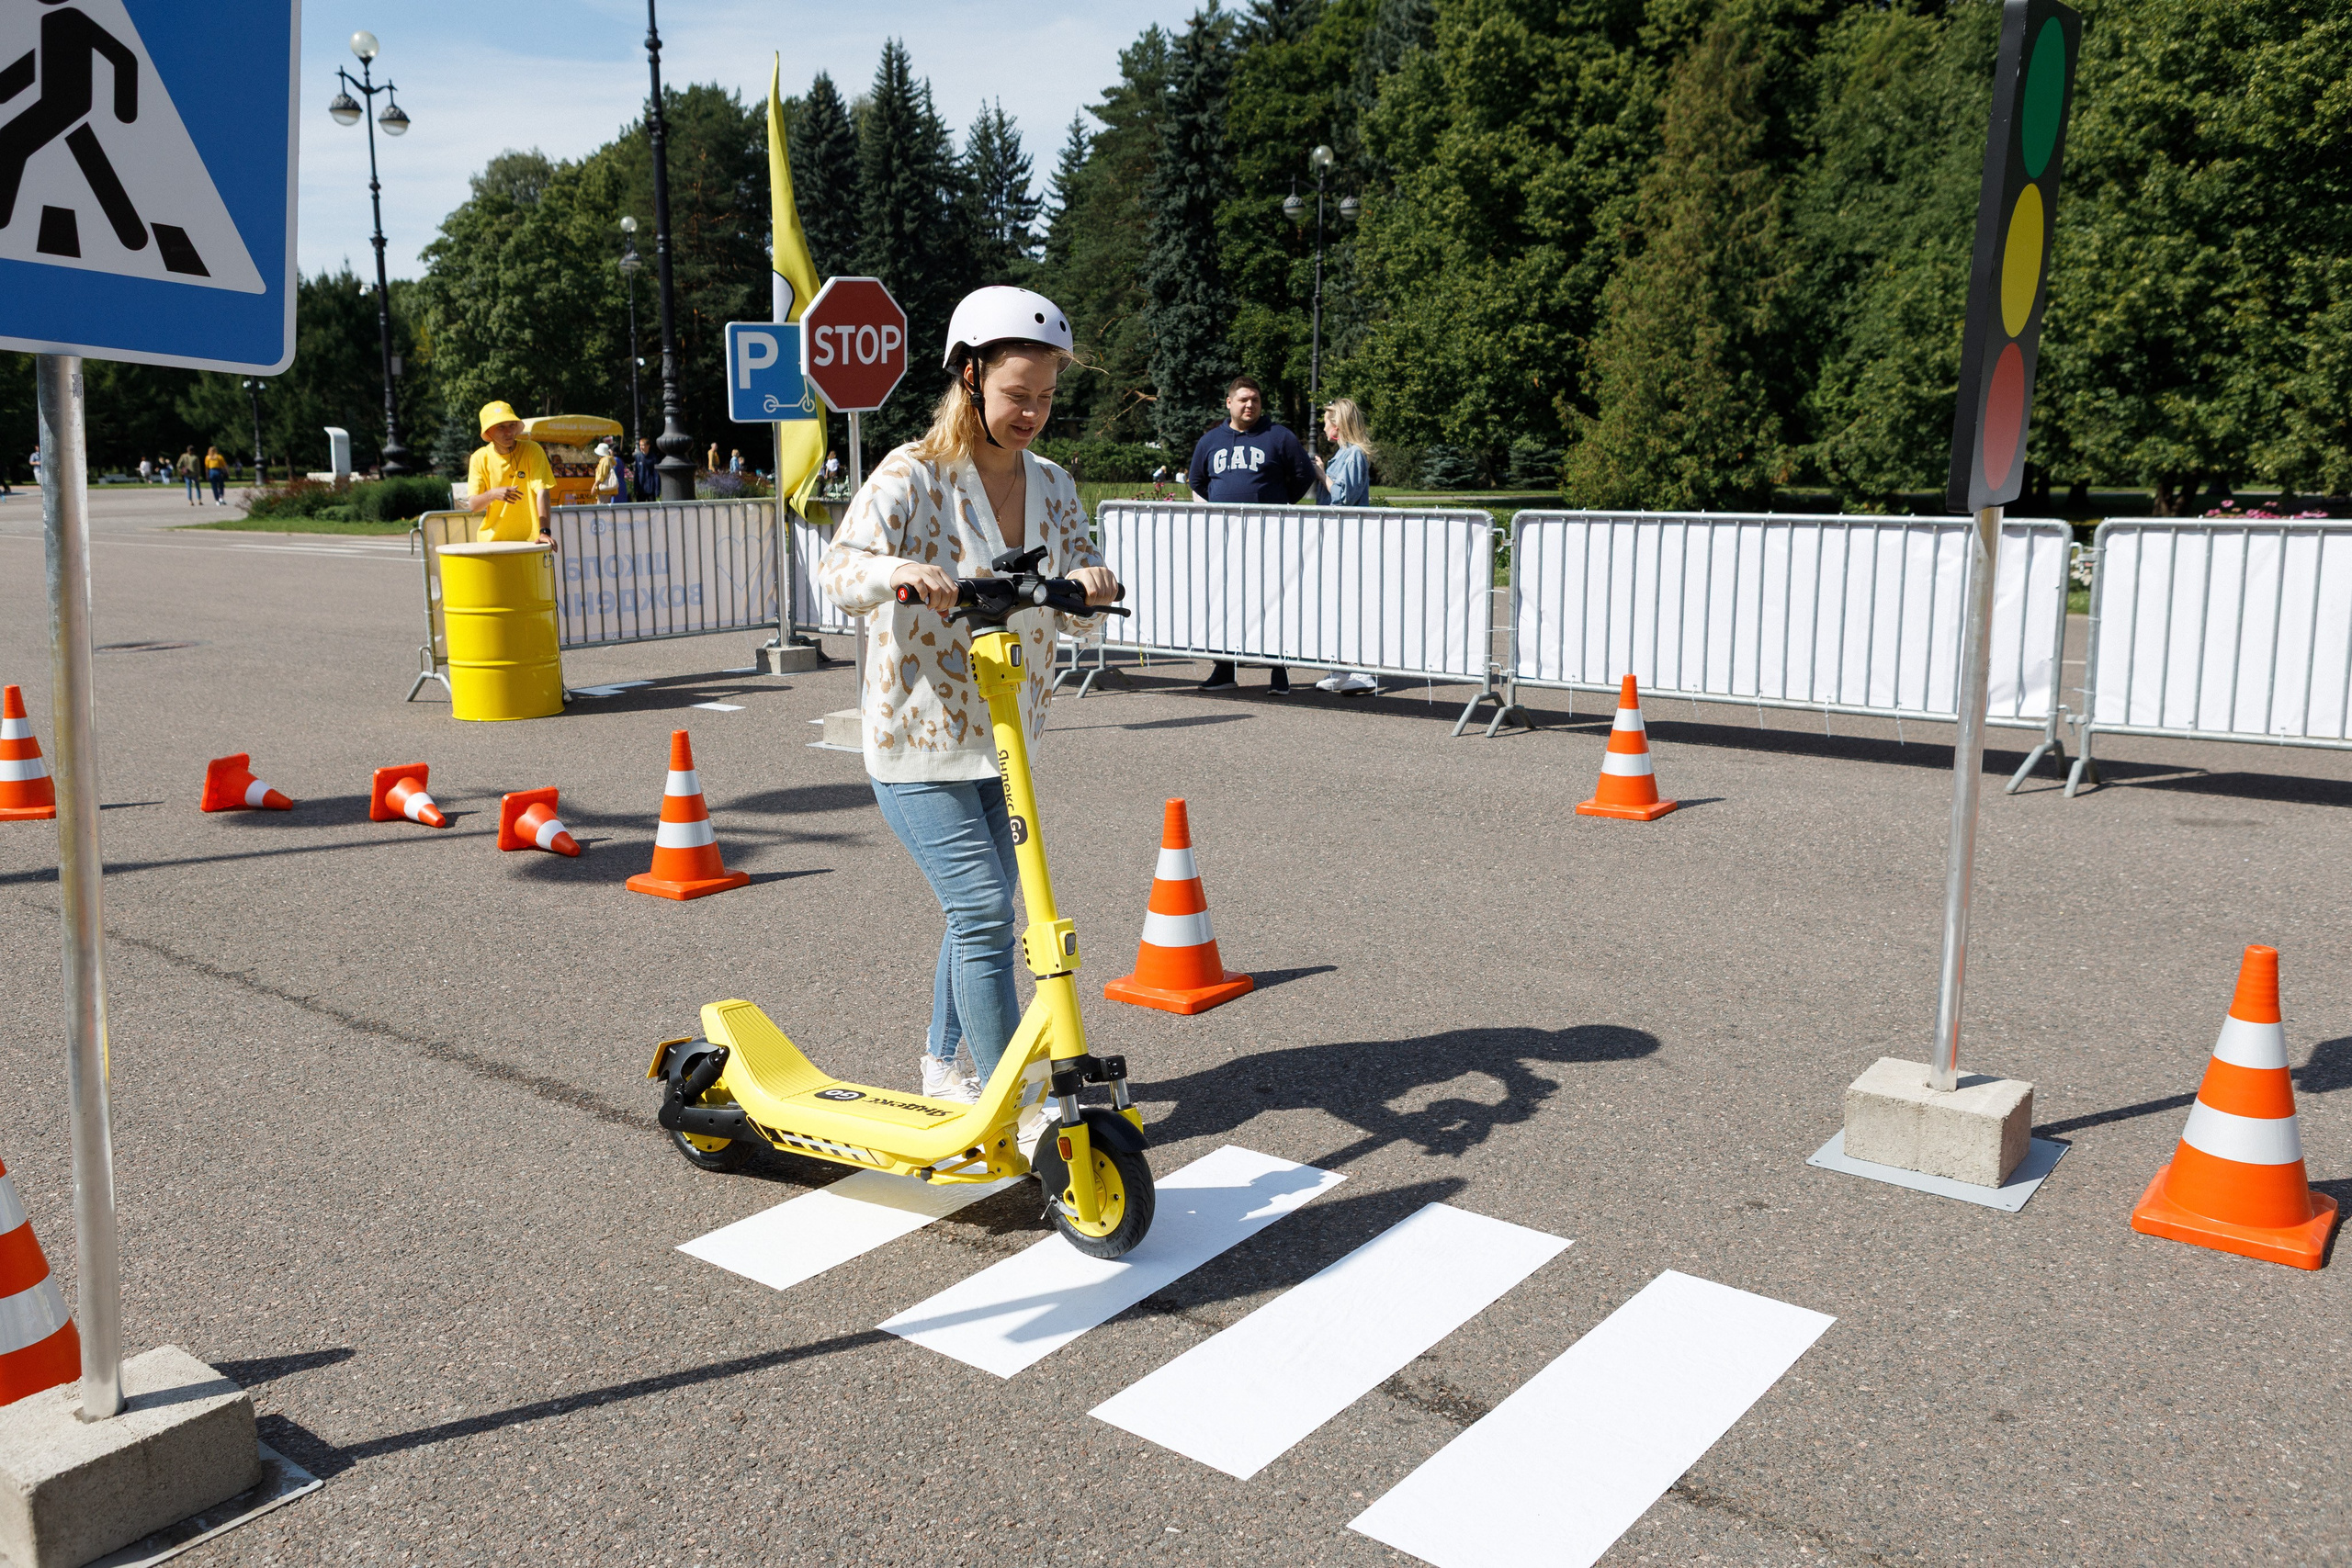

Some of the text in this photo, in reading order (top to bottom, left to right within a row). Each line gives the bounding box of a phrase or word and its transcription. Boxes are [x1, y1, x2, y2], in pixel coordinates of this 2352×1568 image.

[813, 324, 902, 367] STOP
[737, 332, 779, 389] P
[1213, 446, 1266, 475] GAP
[1010, 818, 1022, 843] Go
[825, 1089, 955, 1117] Яндекс Go
